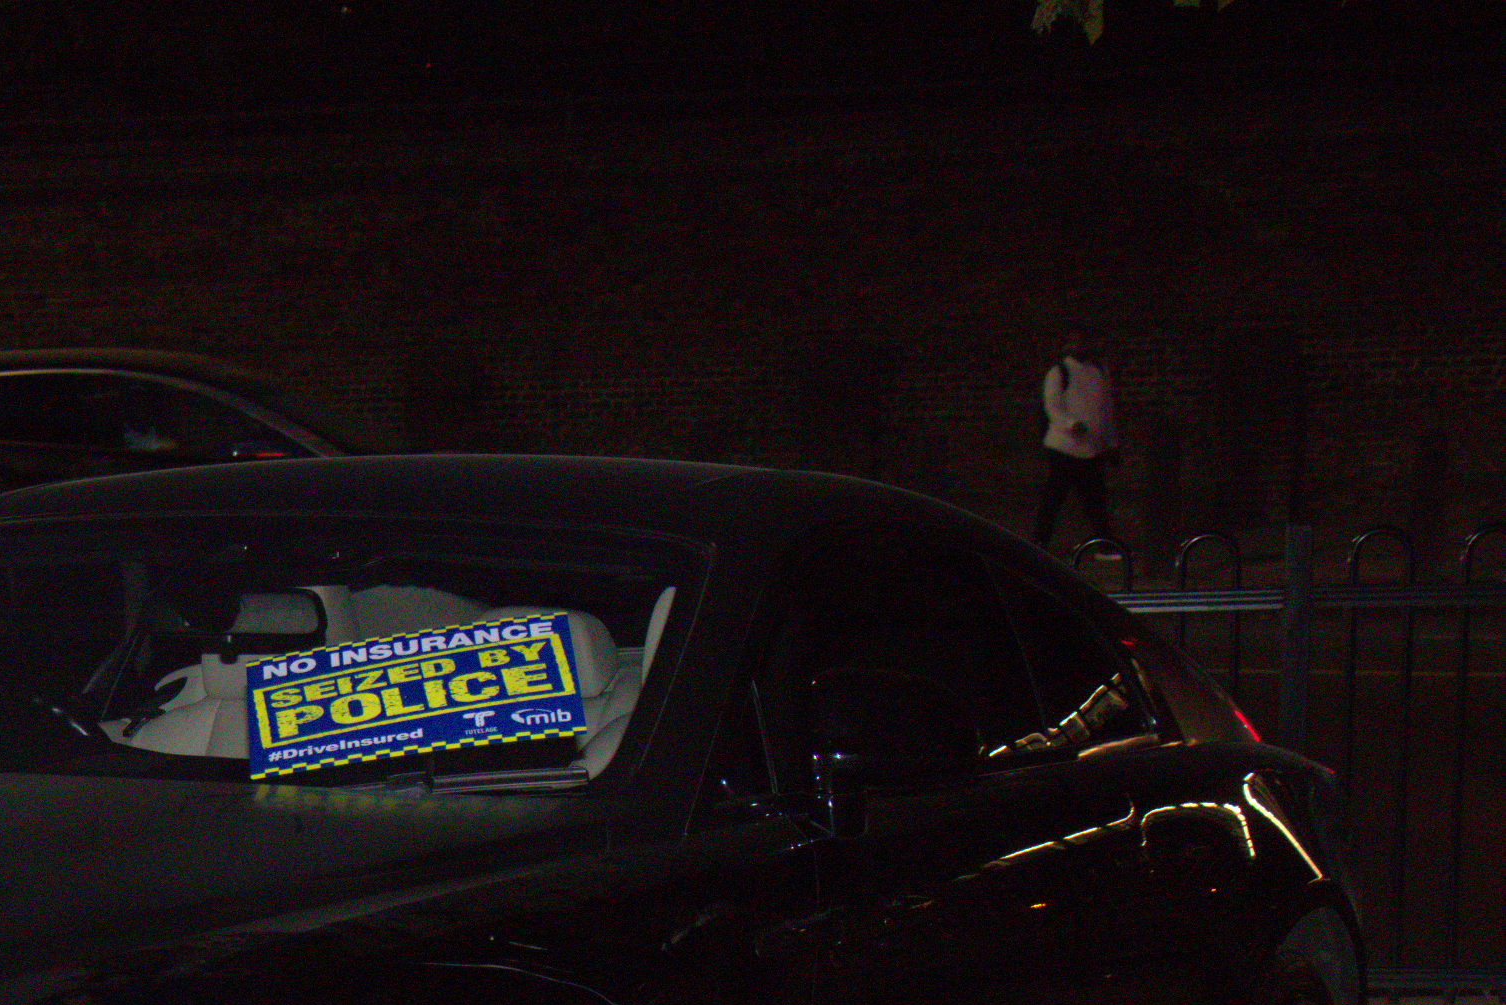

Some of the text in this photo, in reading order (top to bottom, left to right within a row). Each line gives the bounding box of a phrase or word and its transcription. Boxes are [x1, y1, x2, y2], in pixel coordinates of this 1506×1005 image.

[262, 621, 555, 680] NO INSURANCE
[270, 642, 547, 709] SEIZED BY
[275, 663, 554, 739] POLICE
[525, 708, 572, 726] mib
[268, 728, 423, 763] #DriveInsured
